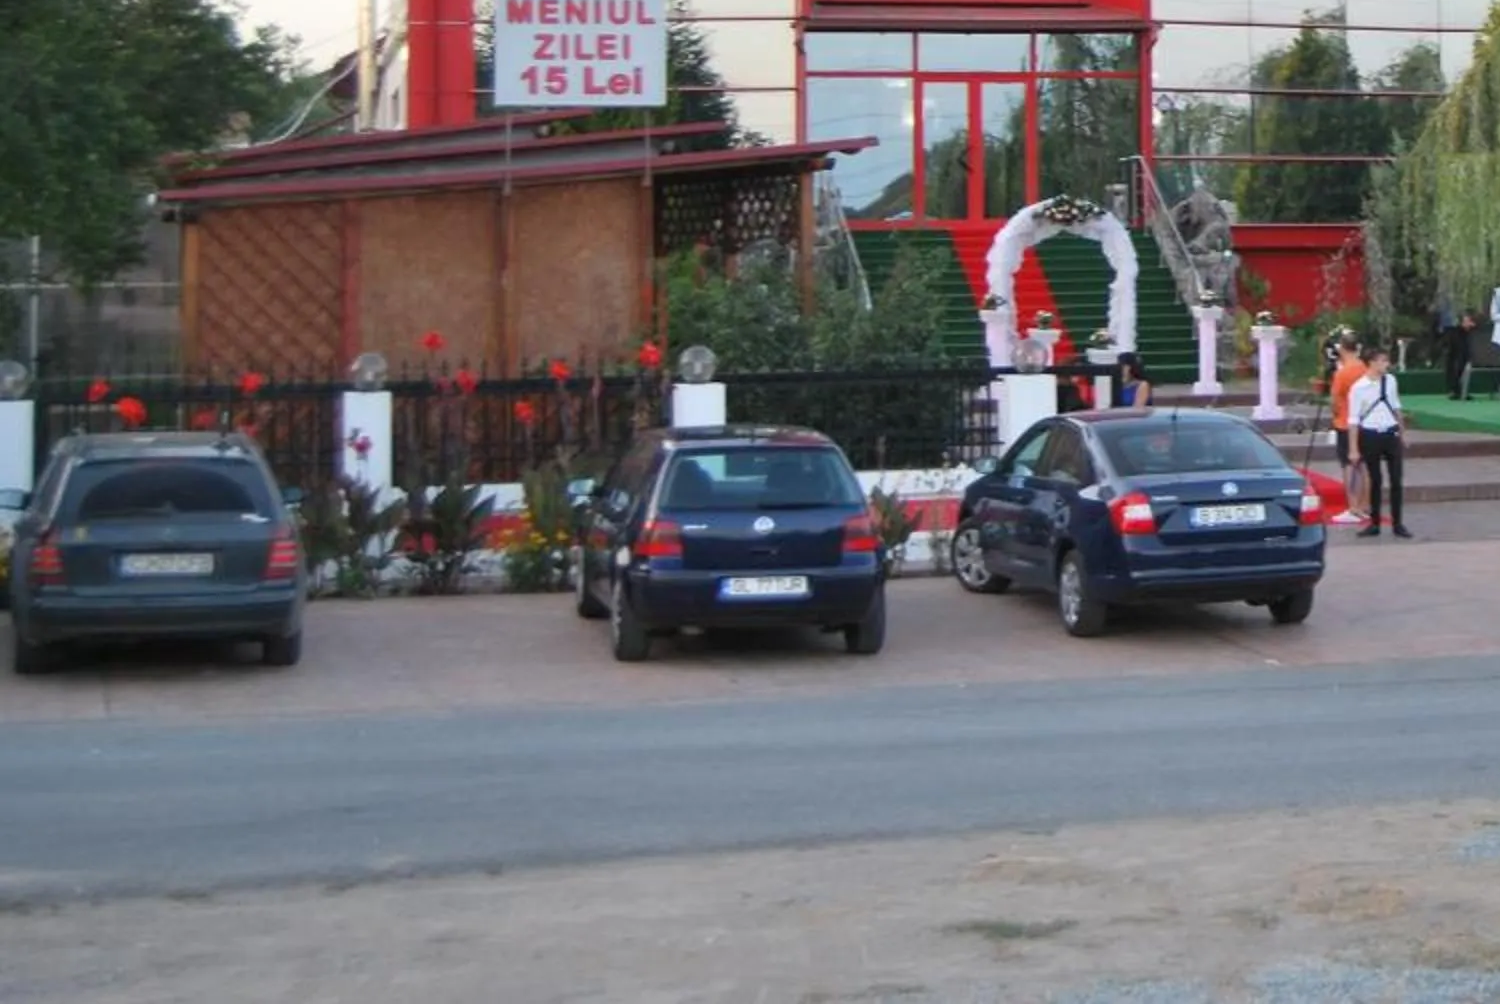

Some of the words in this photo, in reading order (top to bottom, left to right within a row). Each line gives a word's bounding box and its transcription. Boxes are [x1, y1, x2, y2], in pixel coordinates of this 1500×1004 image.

[532, 33, 631, 61] ZILEI
[520, 65, 568, 95] 15
[583, 65, 643, 95] Lei
